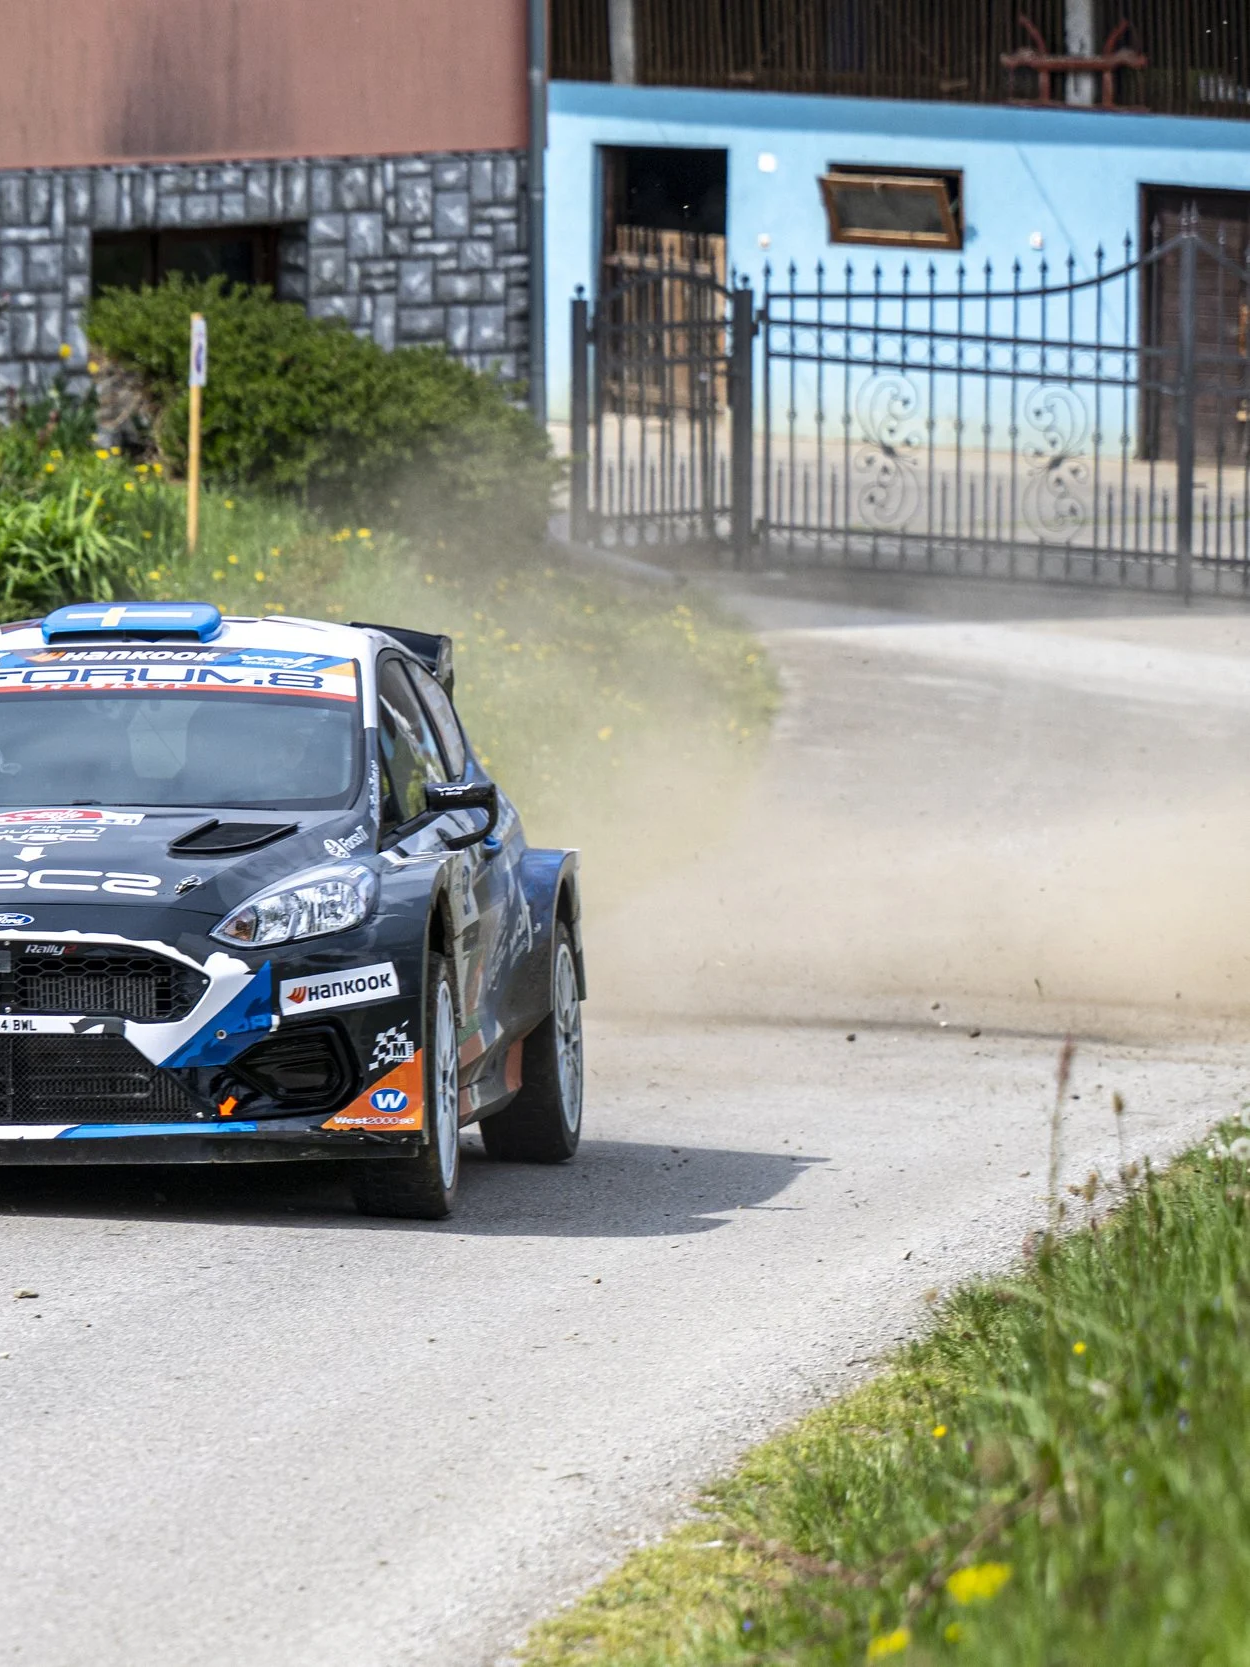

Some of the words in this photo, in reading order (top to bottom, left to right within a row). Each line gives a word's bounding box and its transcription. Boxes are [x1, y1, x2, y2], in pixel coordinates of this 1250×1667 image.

[25, 943, 78, 956] Rally2
[308, 972, 392, 1002] HANKOOK
[12, 1019, 38, 1031] BWL
[375, 1091, 406, 1109] W
